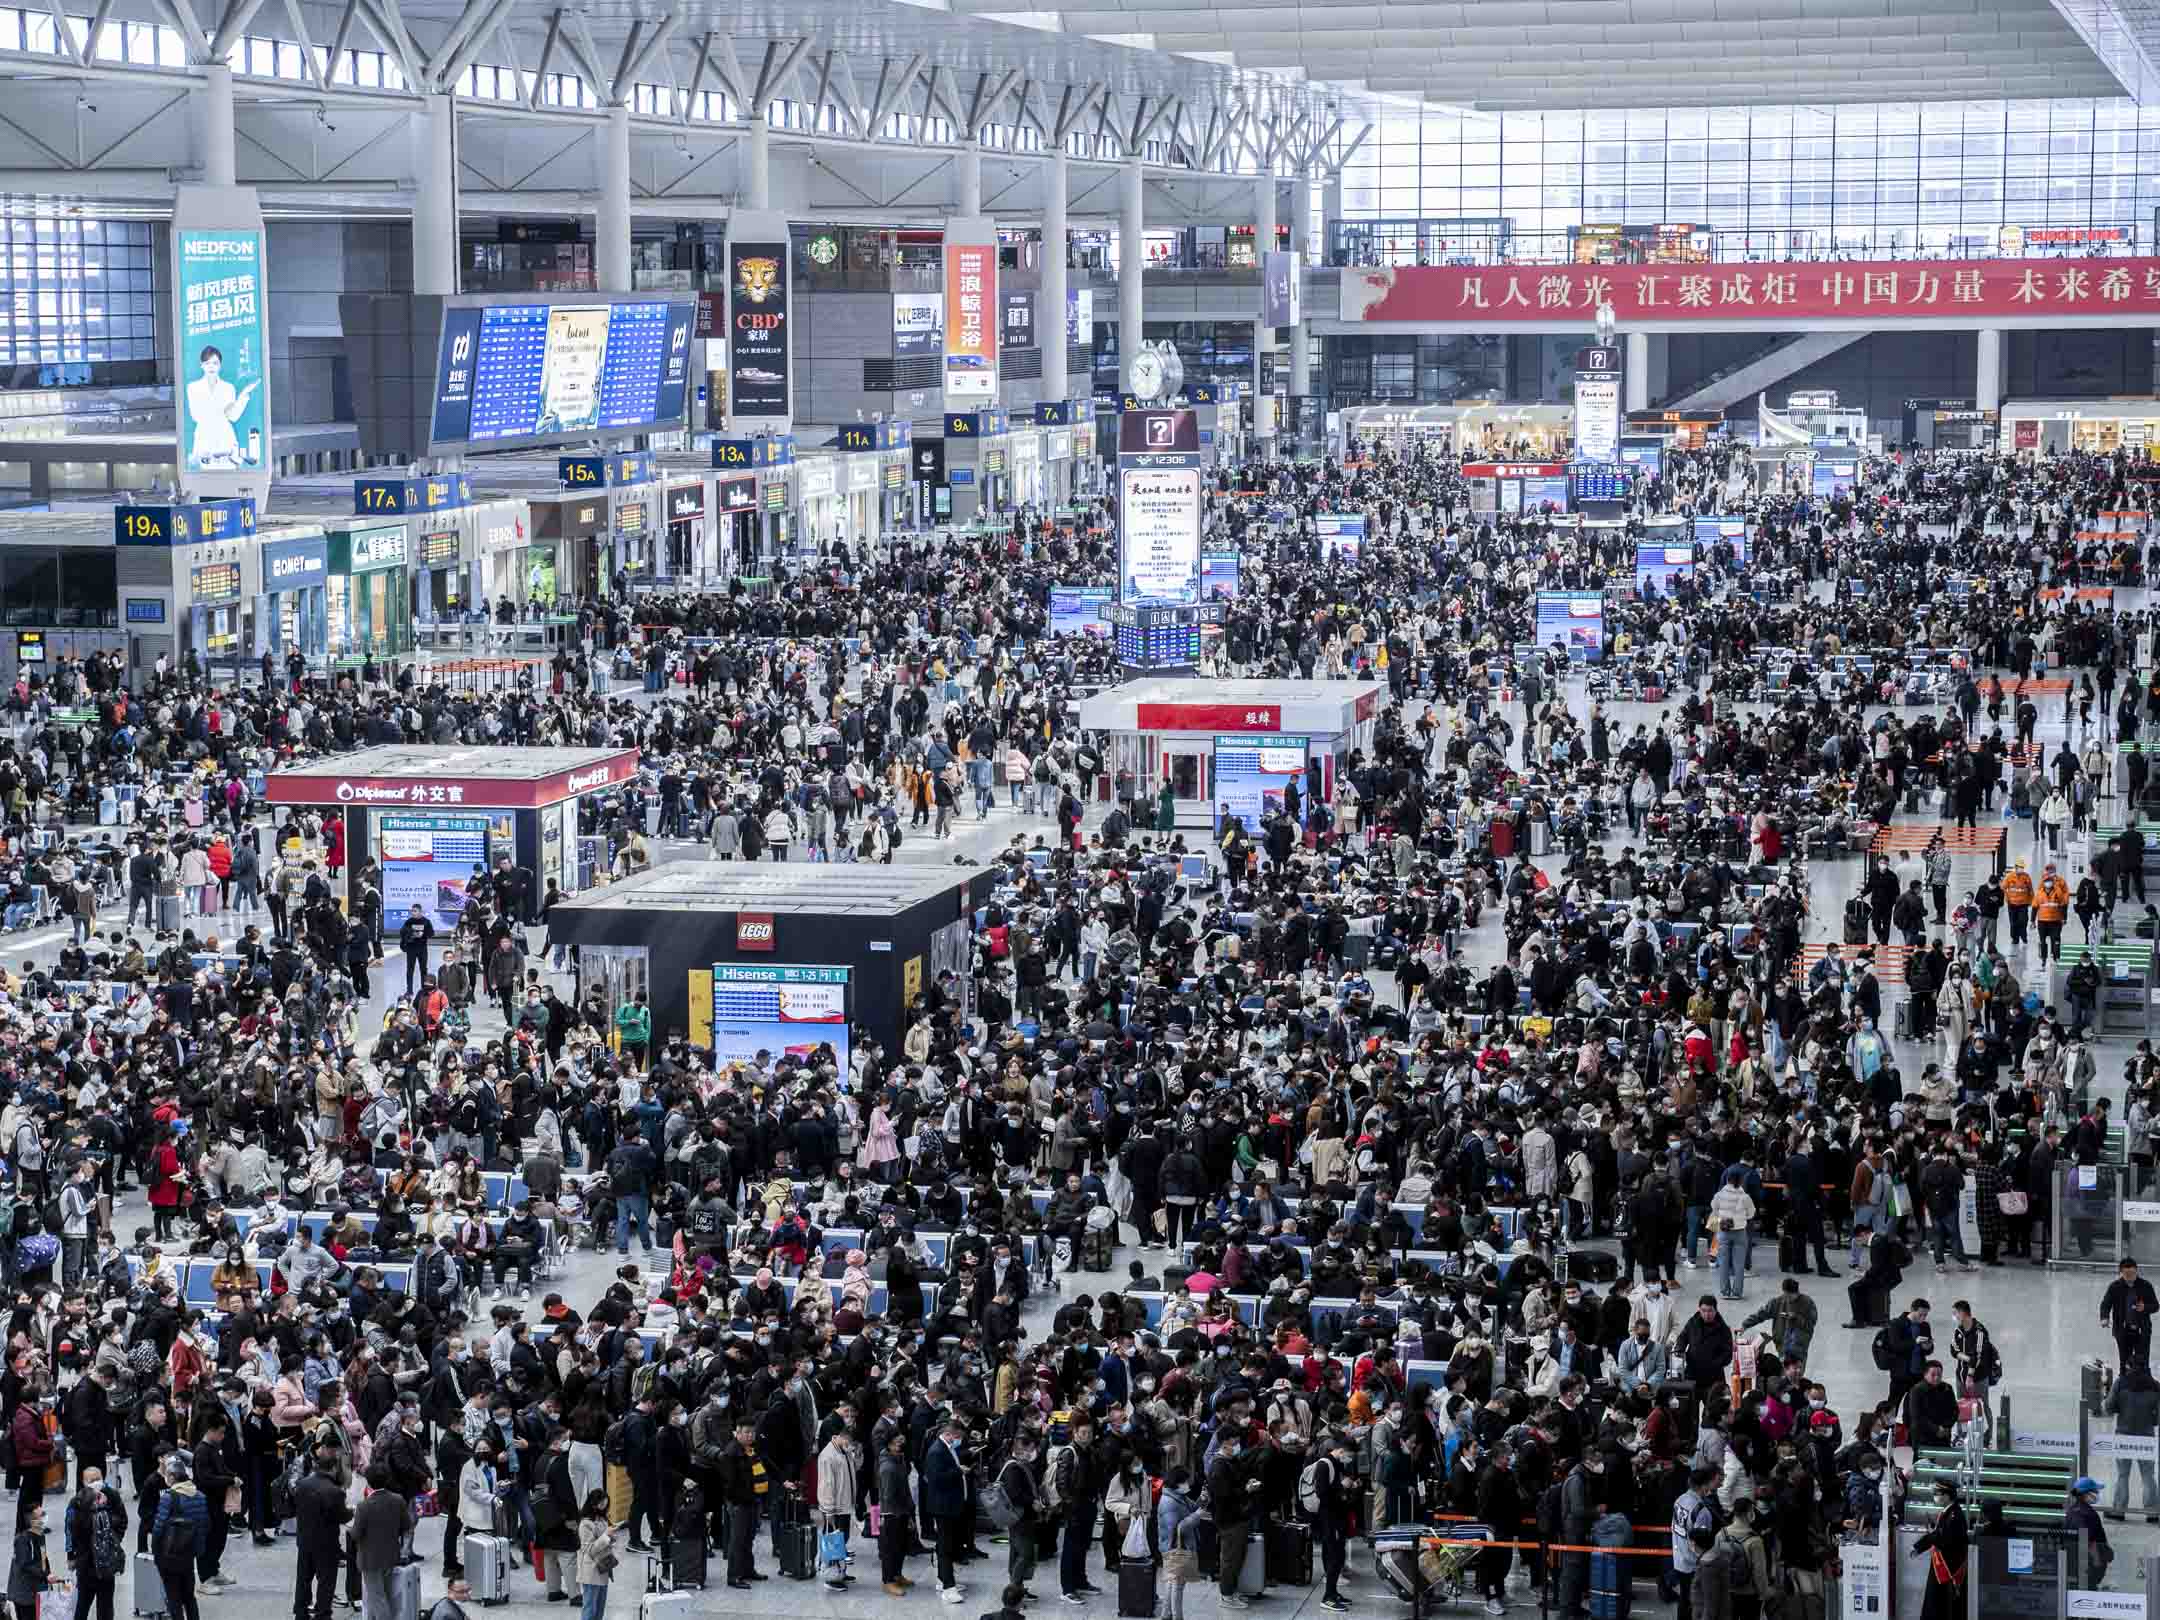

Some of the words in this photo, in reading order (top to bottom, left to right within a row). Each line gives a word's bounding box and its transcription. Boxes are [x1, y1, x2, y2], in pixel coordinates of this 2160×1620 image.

[184, 240, 255, 255] NEDFON
[1457, 275, 1615, 309] 凡人微光
[1637, 272, 1799, 308] 汇聚成炬
[1822, 269, 1985, 305] 中国力量
[737, 313, 779, 329] CBD
[747, 329, 769, 341] 家居
[1196, 389, 1210, 401] 3A
[1043, 407, 1059, 421] 7A
[953, 418, 969, 432] 9A
[846, 431, 869, 447] 11A
[719, 446, 745, 462] 13A
[1155, 455, 1186, 464] 12306
[566, 463, 597, 481] 15A
[362, 487, 396, 508] 17A
[240, 506, 254, 528] 18A
[125, 514, 161, 537] 19A
[411, 785, 464, 802] 外交官
[388, 819, 432, 828] Hisense
[739, 923, 772, 939] LEGO
[722, 967, 777, 980] Hisense
